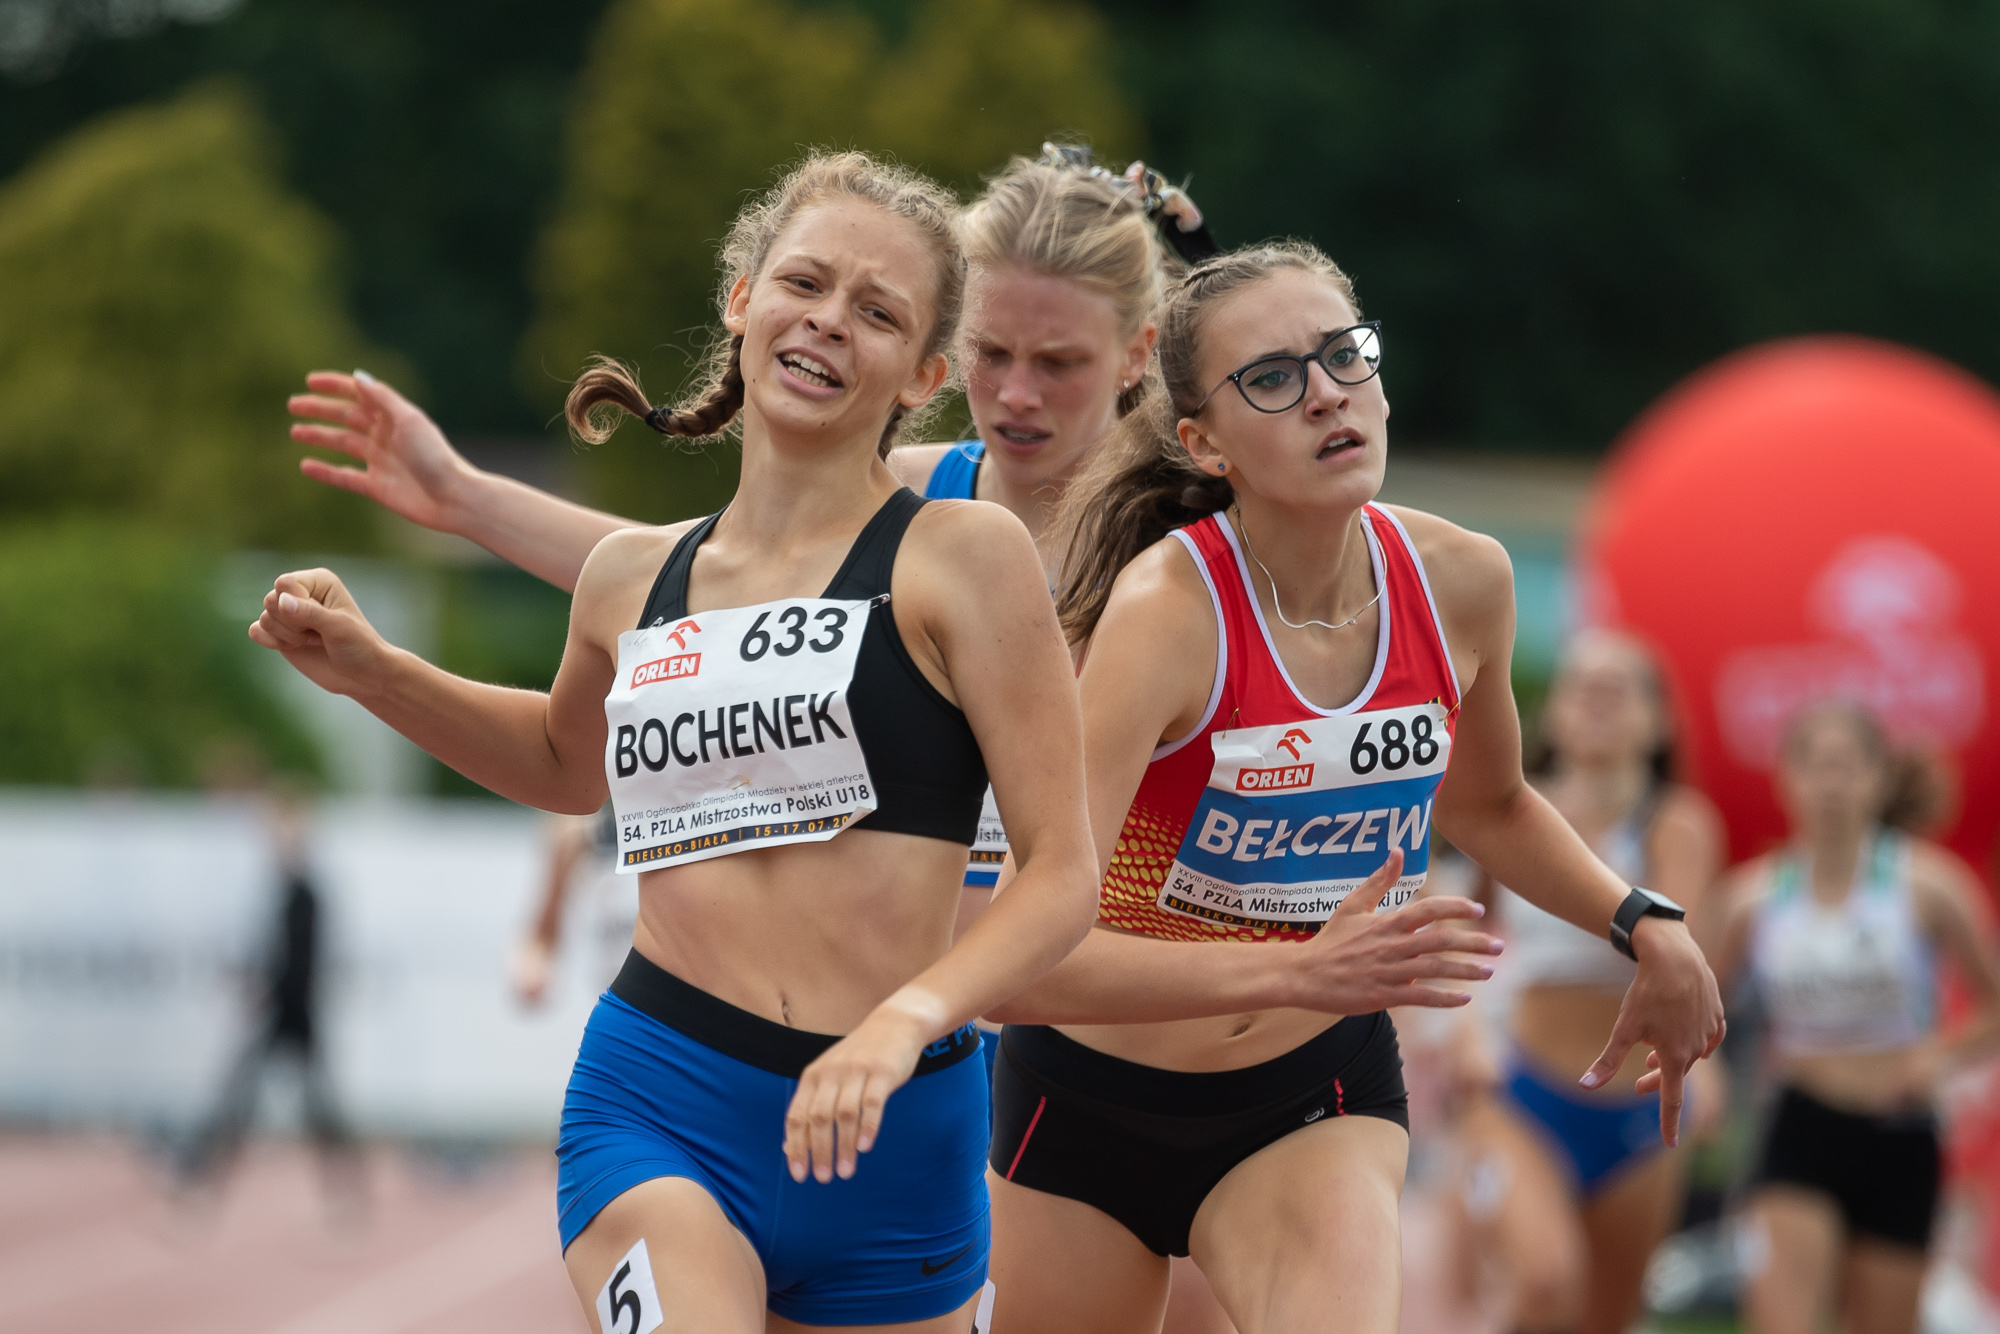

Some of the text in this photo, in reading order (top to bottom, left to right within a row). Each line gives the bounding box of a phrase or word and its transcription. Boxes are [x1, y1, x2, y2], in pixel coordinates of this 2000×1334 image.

[740, 606, 848, 662] 633
[634, 656, 697, 685] ORLEN
[615, 690, 848, 779] BOCHENEK
[1350, 714, 1439, 775] 688
[621, 811, 644, 823] XXVIII
[645, 800, 701, 819] Ogólnopolska
[702, 792, 745, 807] Olimpiada
[747, 785, 787, 798] Młodzieży
[796, 780, 824, 792] lekkiej
[826, 773, 865, 787] atletyce
[1241, 767, 1310, 788] ORLEN
[623, 784, 870, 842] 54. PZLA Mistrzostwa Polski U18
[627, 832, 730, 865] BIELSKO-BIAŁA
[1172, 878, 1197, 897] 54.
[1202, 890, 1244, 911] PZLA
[1394, 889, 1419, 906] U1
[1178, 867, 1203, 883] XXVIII
[1204, 879, 1266, 897] Ogólnopolska
[1268, 886, 1313, 897] Olimpiada
[1315, 883, 1354, 893] Młodzieży
[608, 1260, 641, 1334] 5
